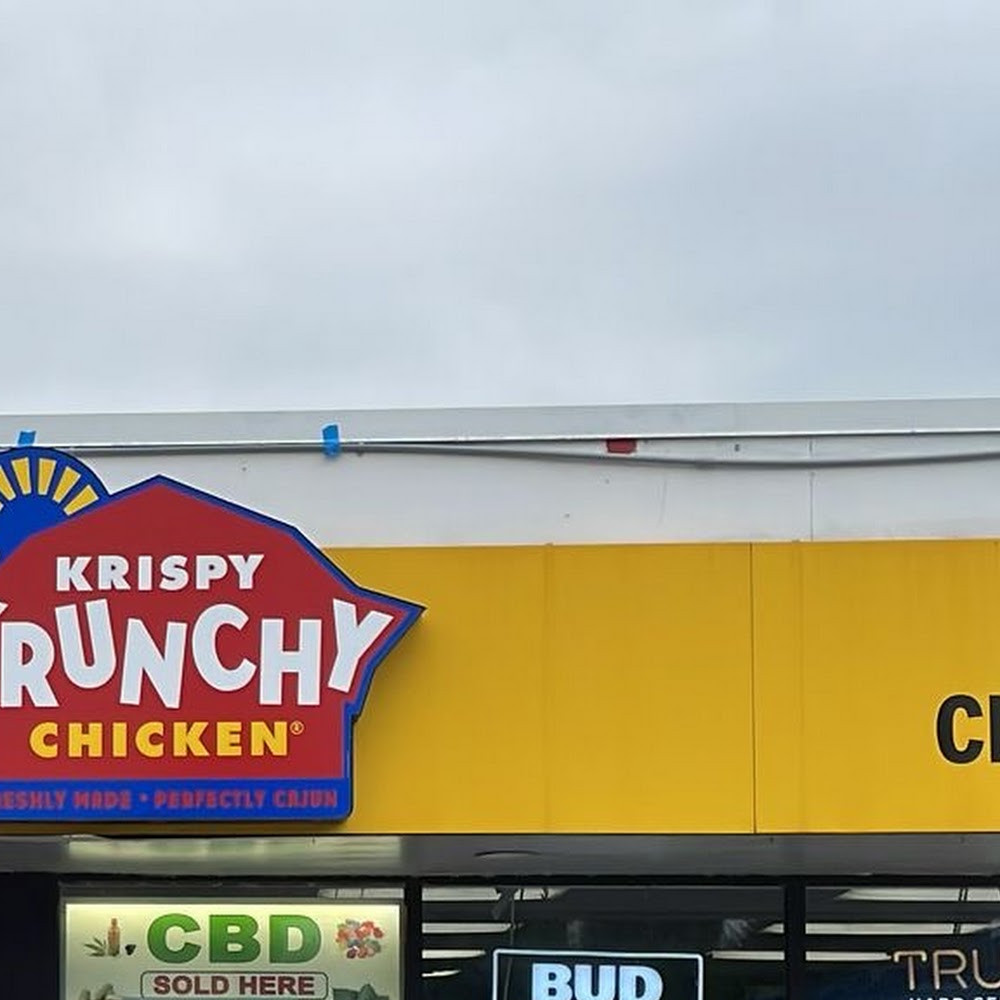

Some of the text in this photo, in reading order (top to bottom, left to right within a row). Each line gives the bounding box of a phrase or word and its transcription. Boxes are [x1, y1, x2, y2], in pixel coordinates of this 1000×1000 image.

[56, 553, 264, 592] KRISPY
[72, 789, 132, 810] MADE
[153, 789, 264, 810] PERFECTLY
[271, 789, 338, 810] CAJUN
[146, 912, 322, 964] CBD
[153, 975, 316, 996] SOLD HERE
